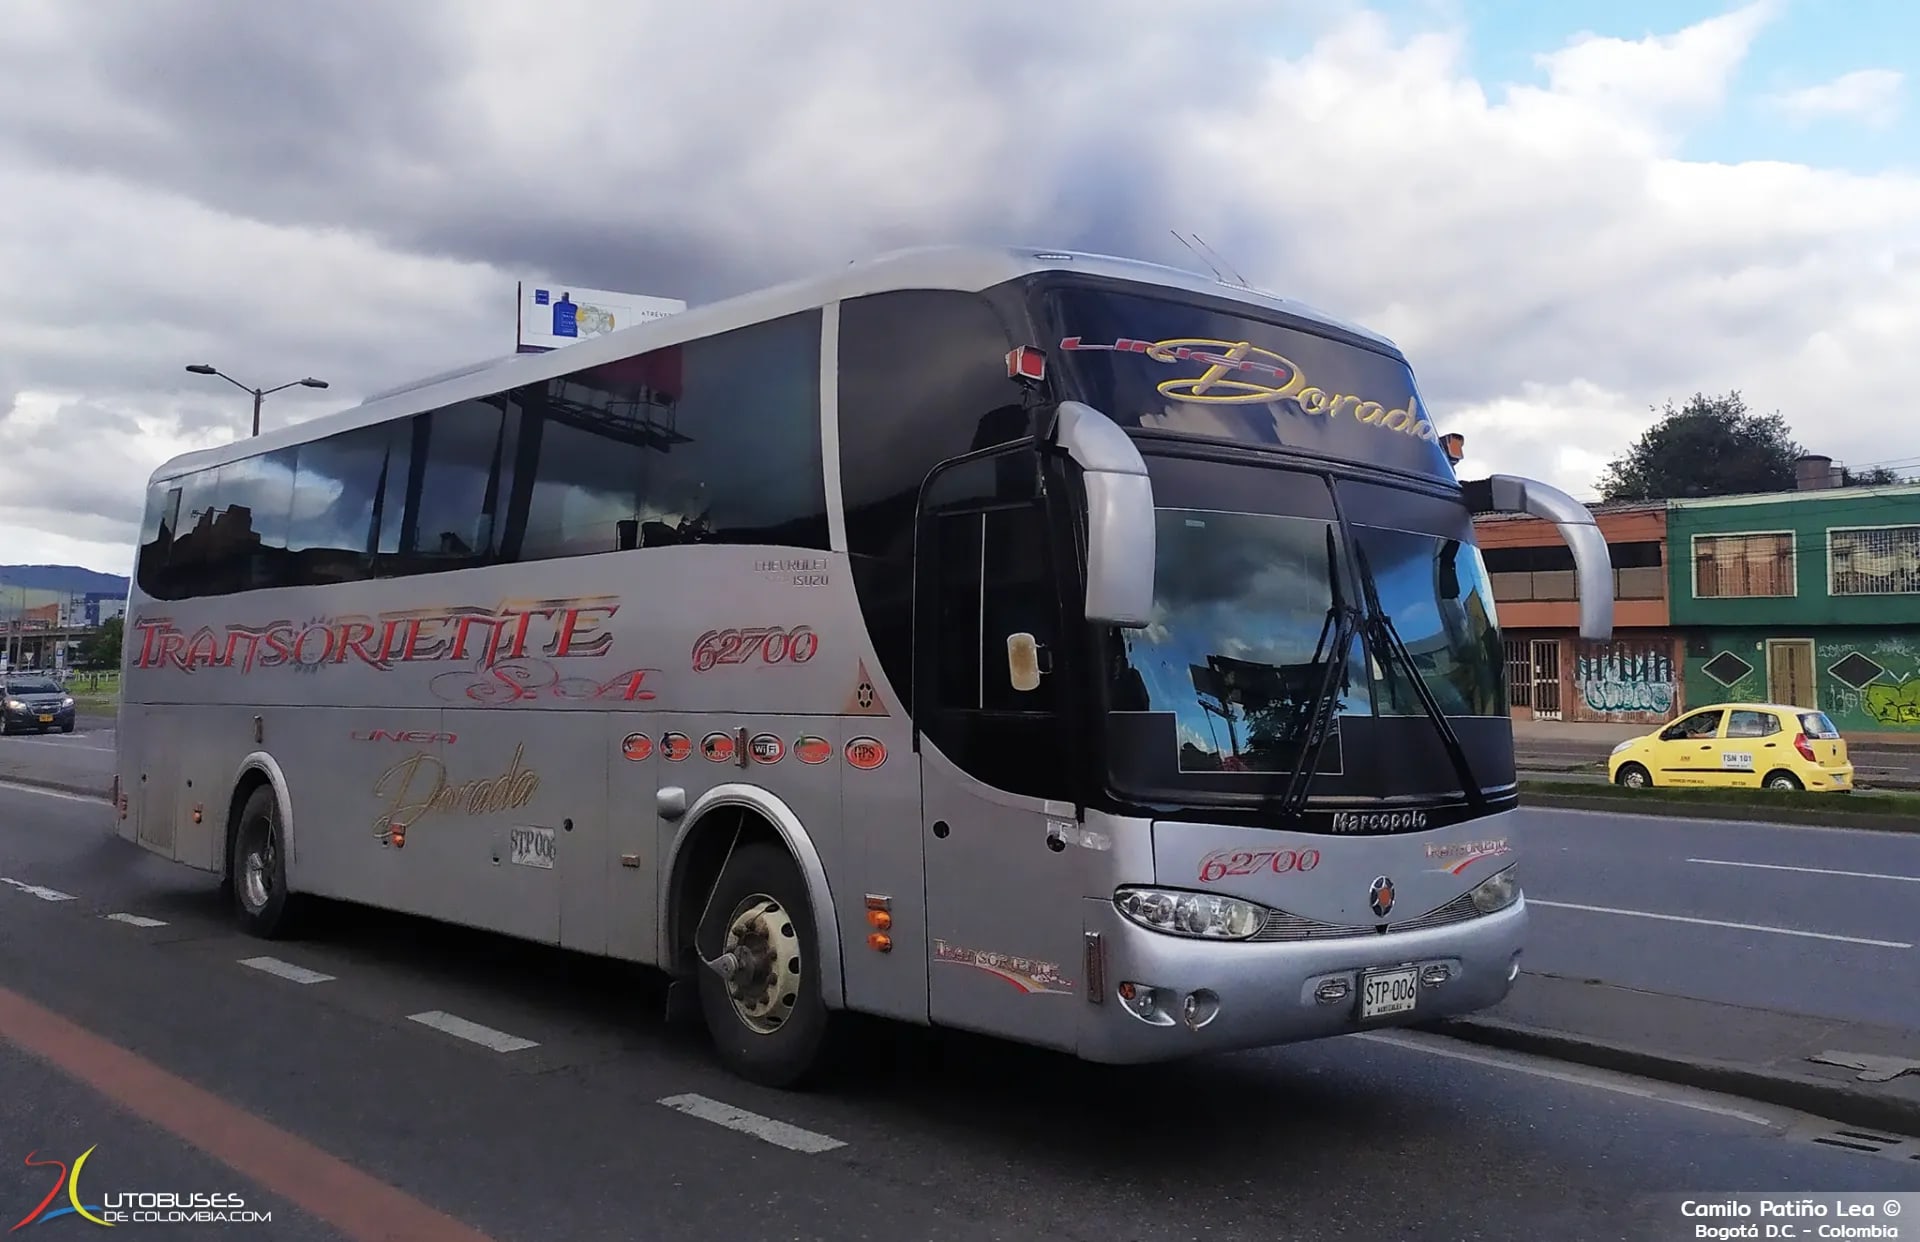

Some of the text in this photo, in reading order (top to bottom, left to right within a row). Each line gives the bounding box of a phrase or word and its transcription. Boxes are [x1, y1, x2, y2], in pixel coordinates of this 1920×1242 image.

[1146, 338, 1437, 441] Dorada
[792, 575, 829, 586] ISUZU
[691, 625, 819, 673] 62700
[373, 741, 542, 839] Dorada
[1331, 811, 1428, 834] Marcopolo
[1198, 845, 1321, 884] 62700
